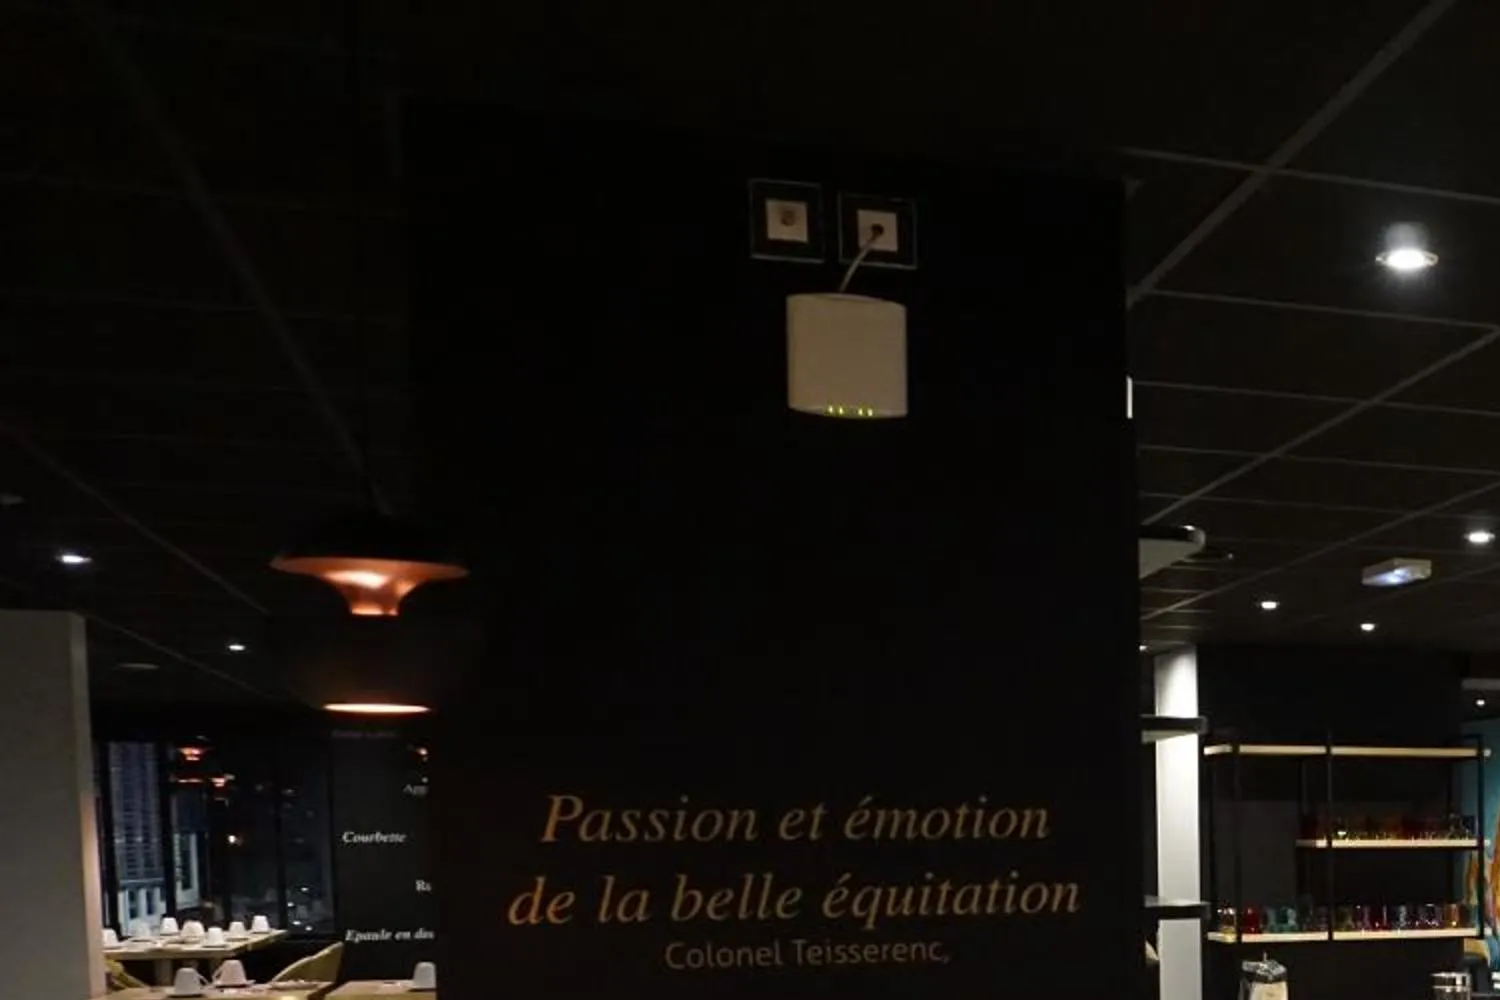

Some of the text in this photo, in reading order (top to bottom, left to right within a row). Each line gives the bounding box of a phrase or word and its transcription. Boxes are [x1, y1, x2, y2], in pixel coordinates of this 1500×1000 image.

[540, 794, 1051, 843] Passion et émotion
[506, 869, 1082, 930] de la belle équitation
[664, 938, 951, 970] Colonel Teisserenc,
